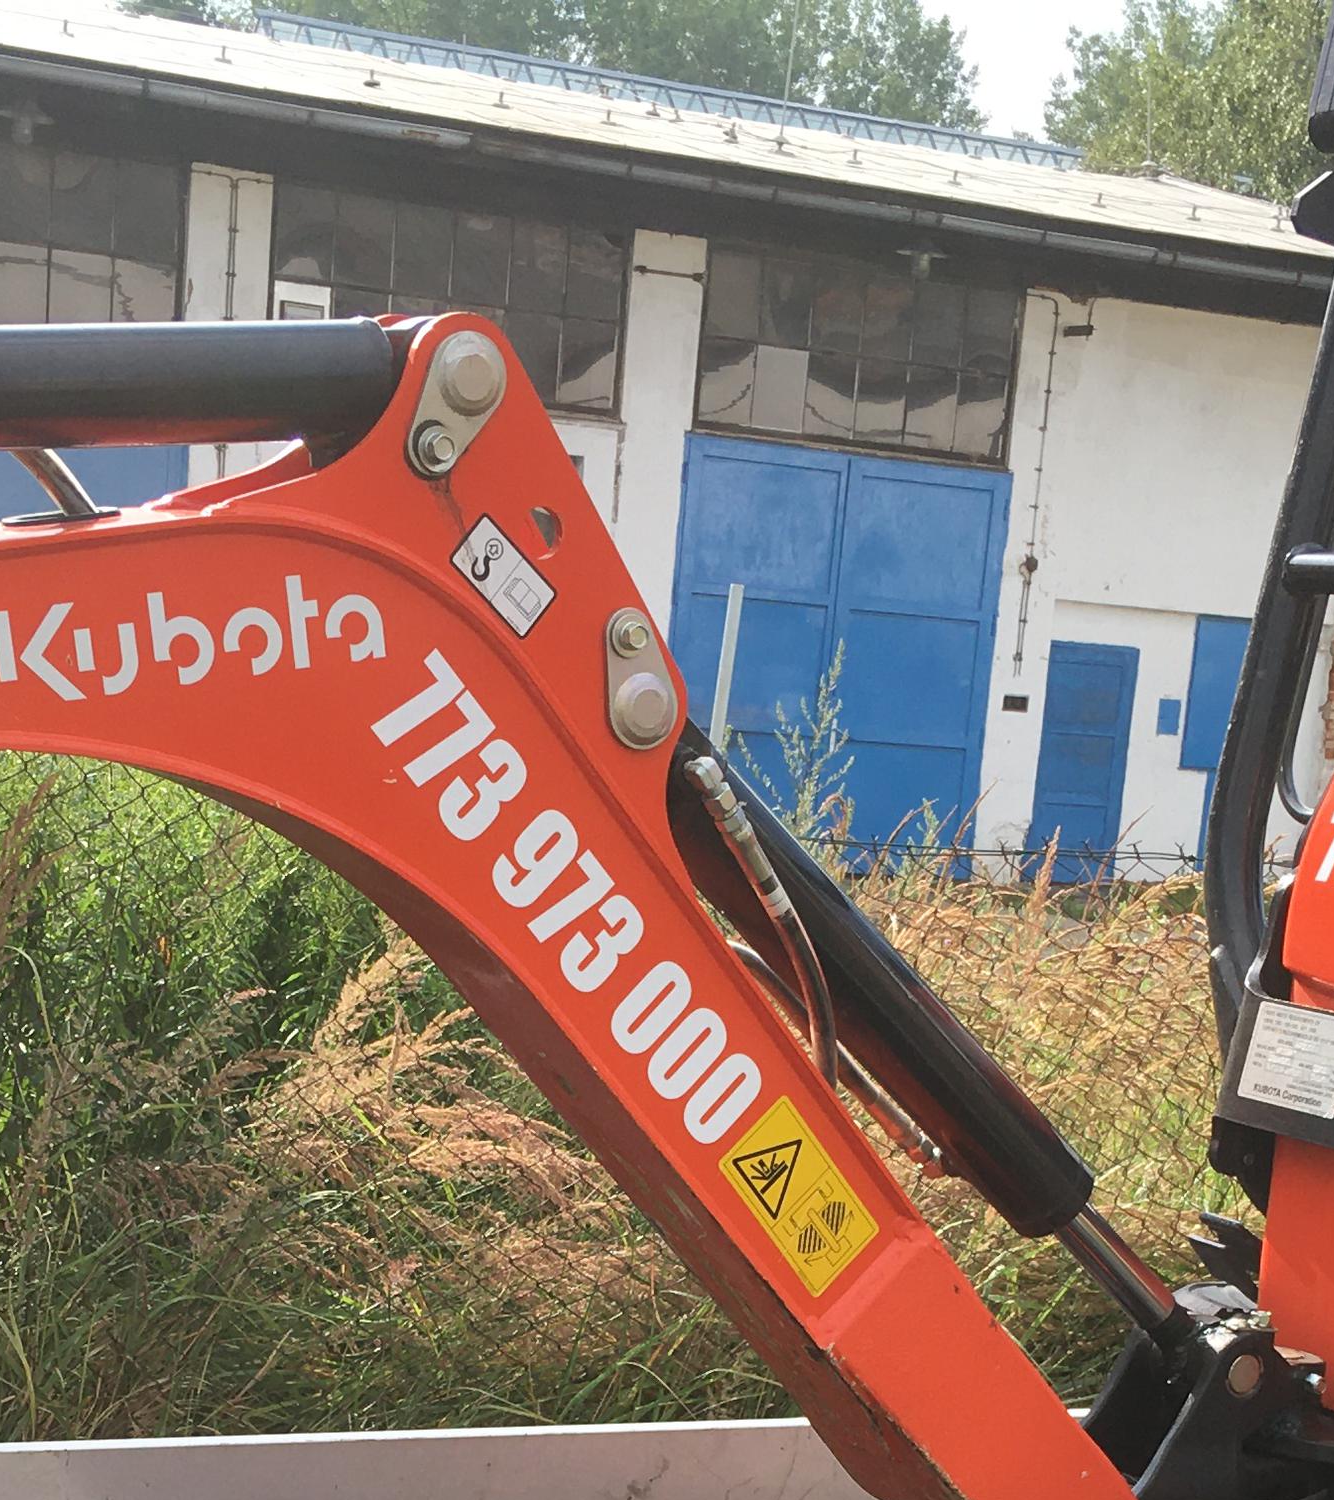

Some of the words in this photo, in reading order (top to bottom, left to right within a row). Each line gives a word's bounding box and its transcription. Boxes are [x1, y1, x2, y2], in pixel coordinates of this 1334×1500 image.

[370, 648, 527, 841] 773
[492, 808, 644, 992] 973
[610, 961, 761, 1144] 000
[1252, 1083, 1281, 1097] KUBOTA
[1281, 1089, 1322, 1107] Corporation
